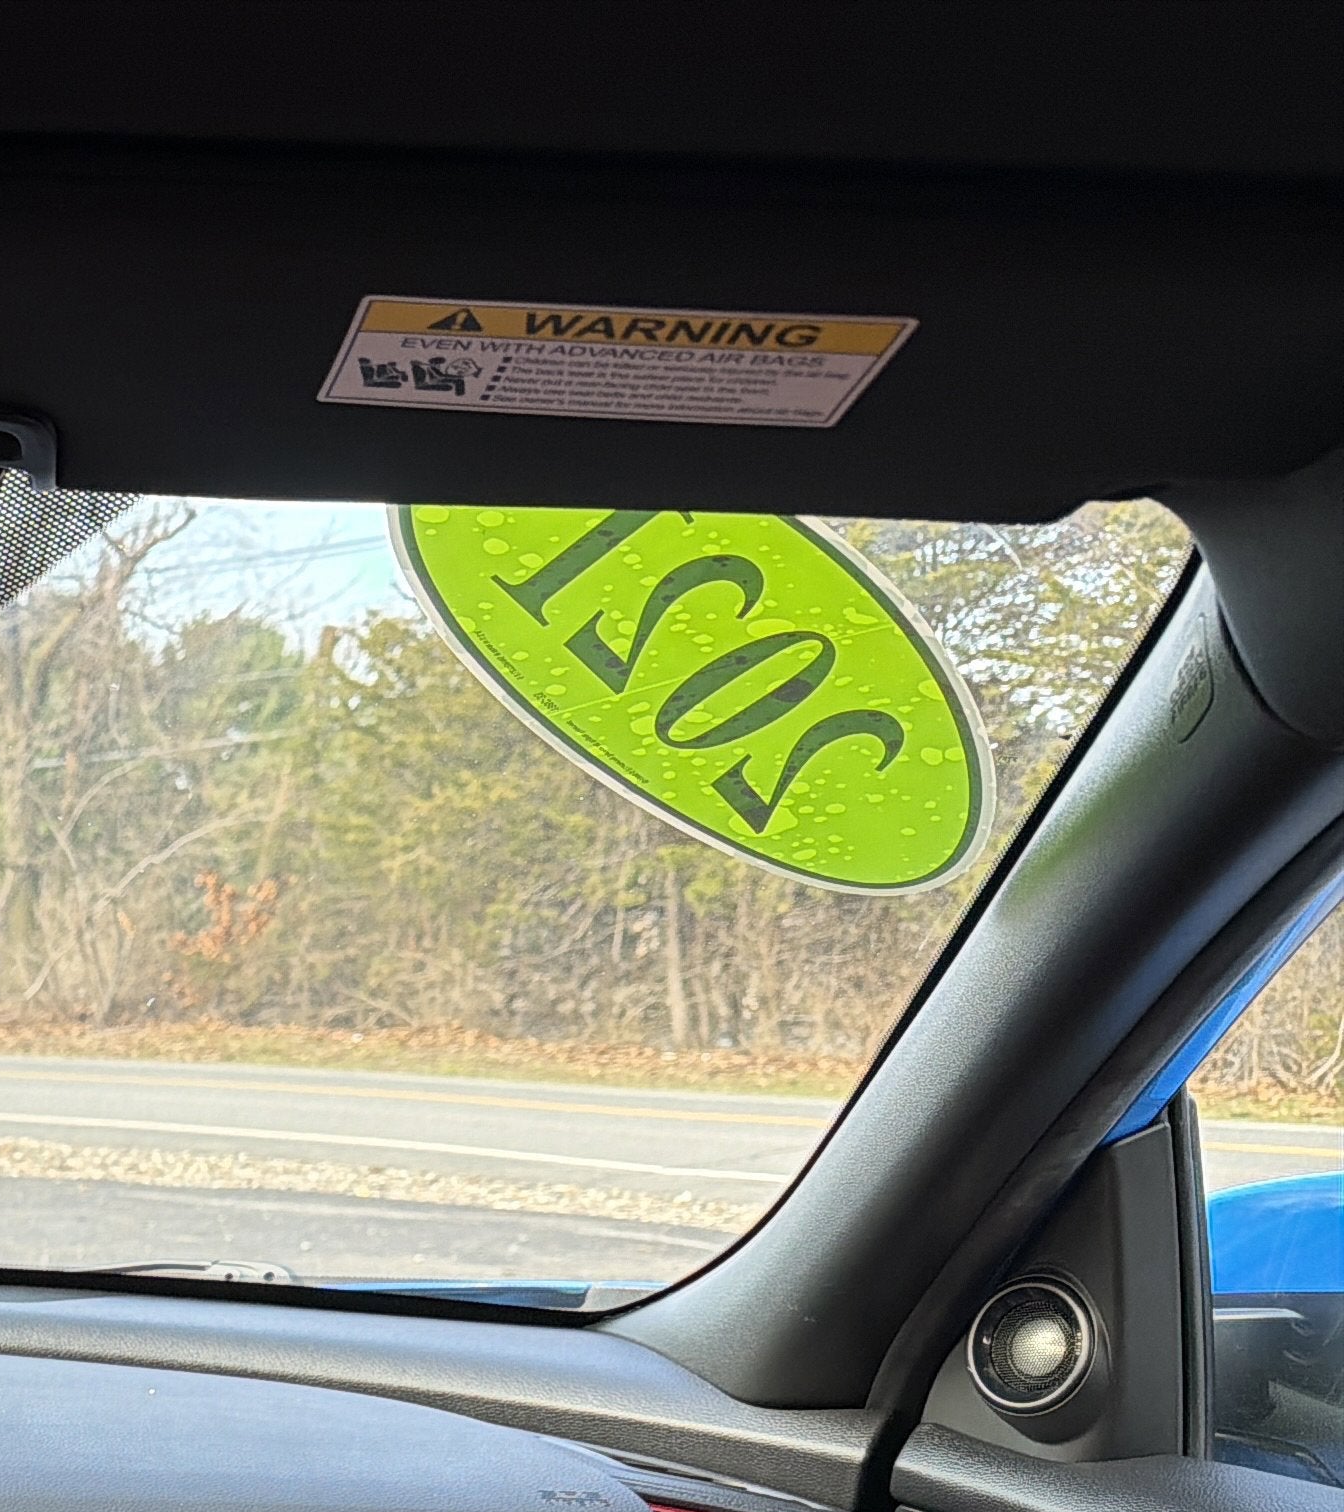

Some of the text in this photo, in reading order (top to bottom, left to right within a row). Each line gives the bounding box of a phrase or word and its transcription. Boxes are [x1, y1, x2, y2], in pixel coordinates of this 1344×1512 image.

[524, 312, 822, 348] WARNING
[400, 337, 827, 367] EVEN WITH ADVANCED AIR BAGS
